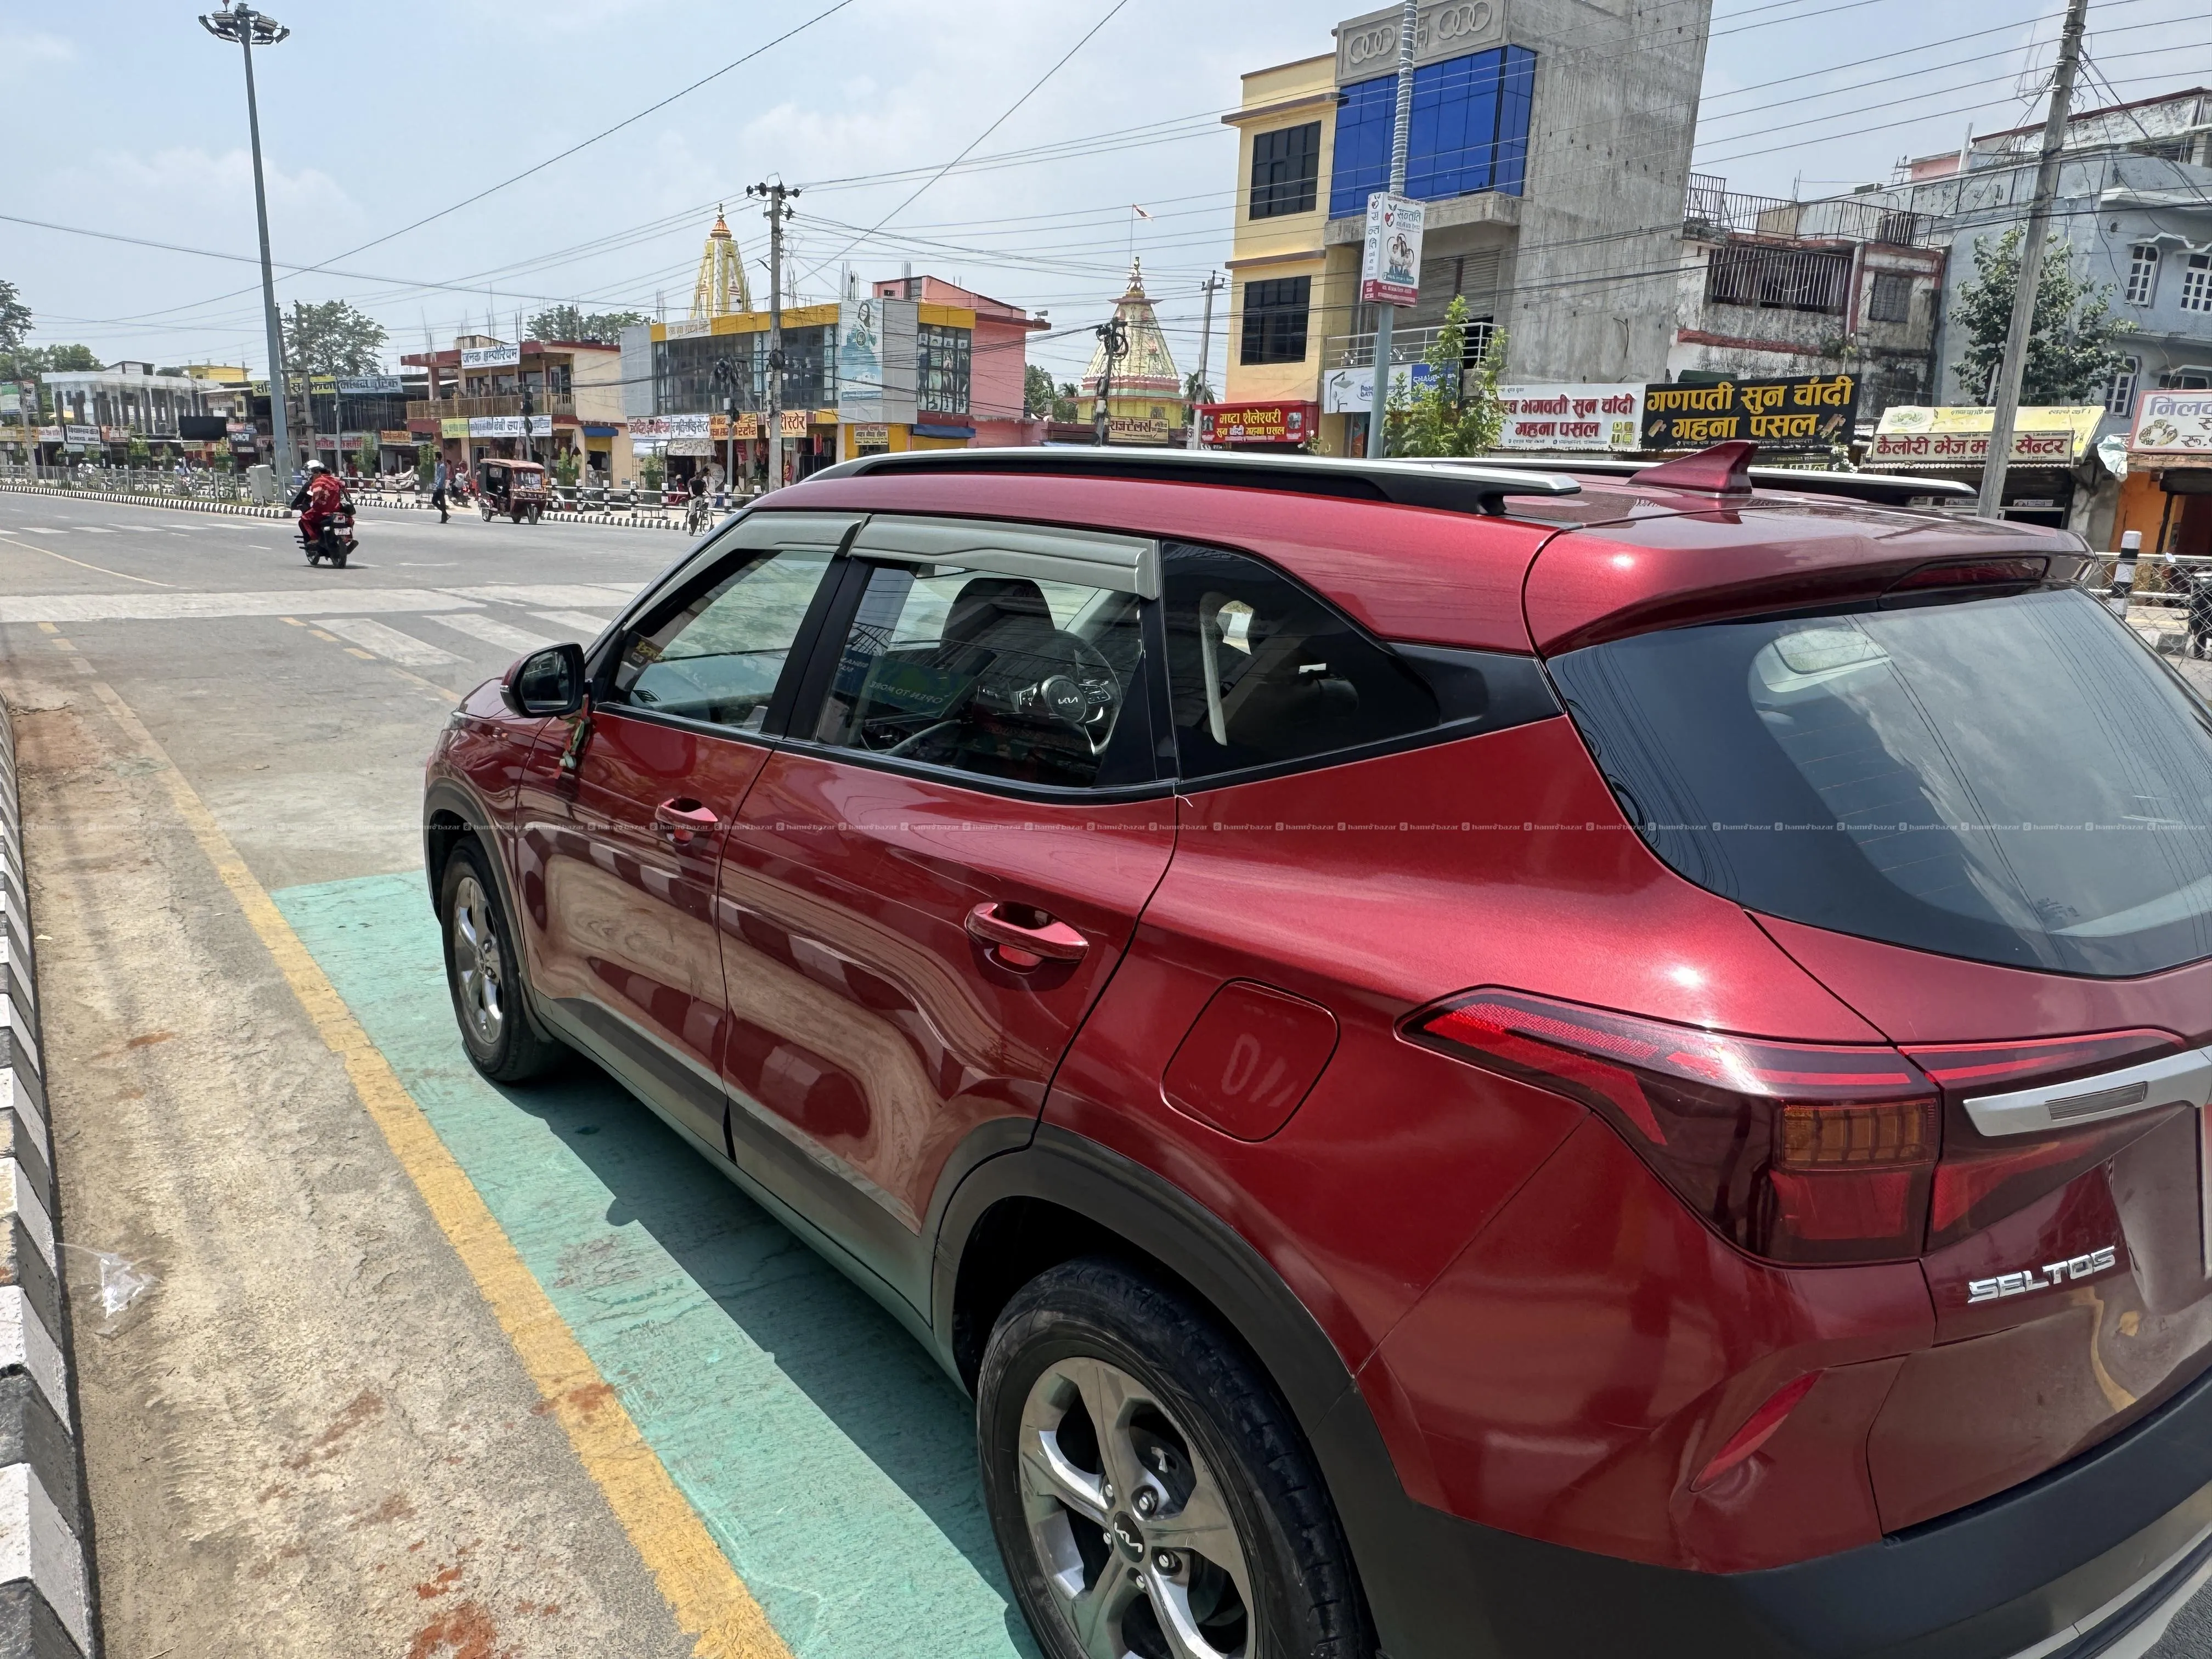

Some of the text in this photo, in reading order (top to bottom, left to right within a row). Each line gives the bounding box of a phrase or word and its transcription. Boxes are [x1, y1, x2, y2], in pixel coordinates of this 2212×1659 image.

[1521, 393, 1570, 415] भगवती
[1572, 399, 1599, 419] सुन
[1647, 382, 1735, 411] गणपती
[1740, 386, 1787, 414] सुन
[1515, 421, 1600, 437] गहना पसल
[1672, 414, 1820, 441] गहना पसल
[1967, 1245, 2115, 1304] SELTOS
